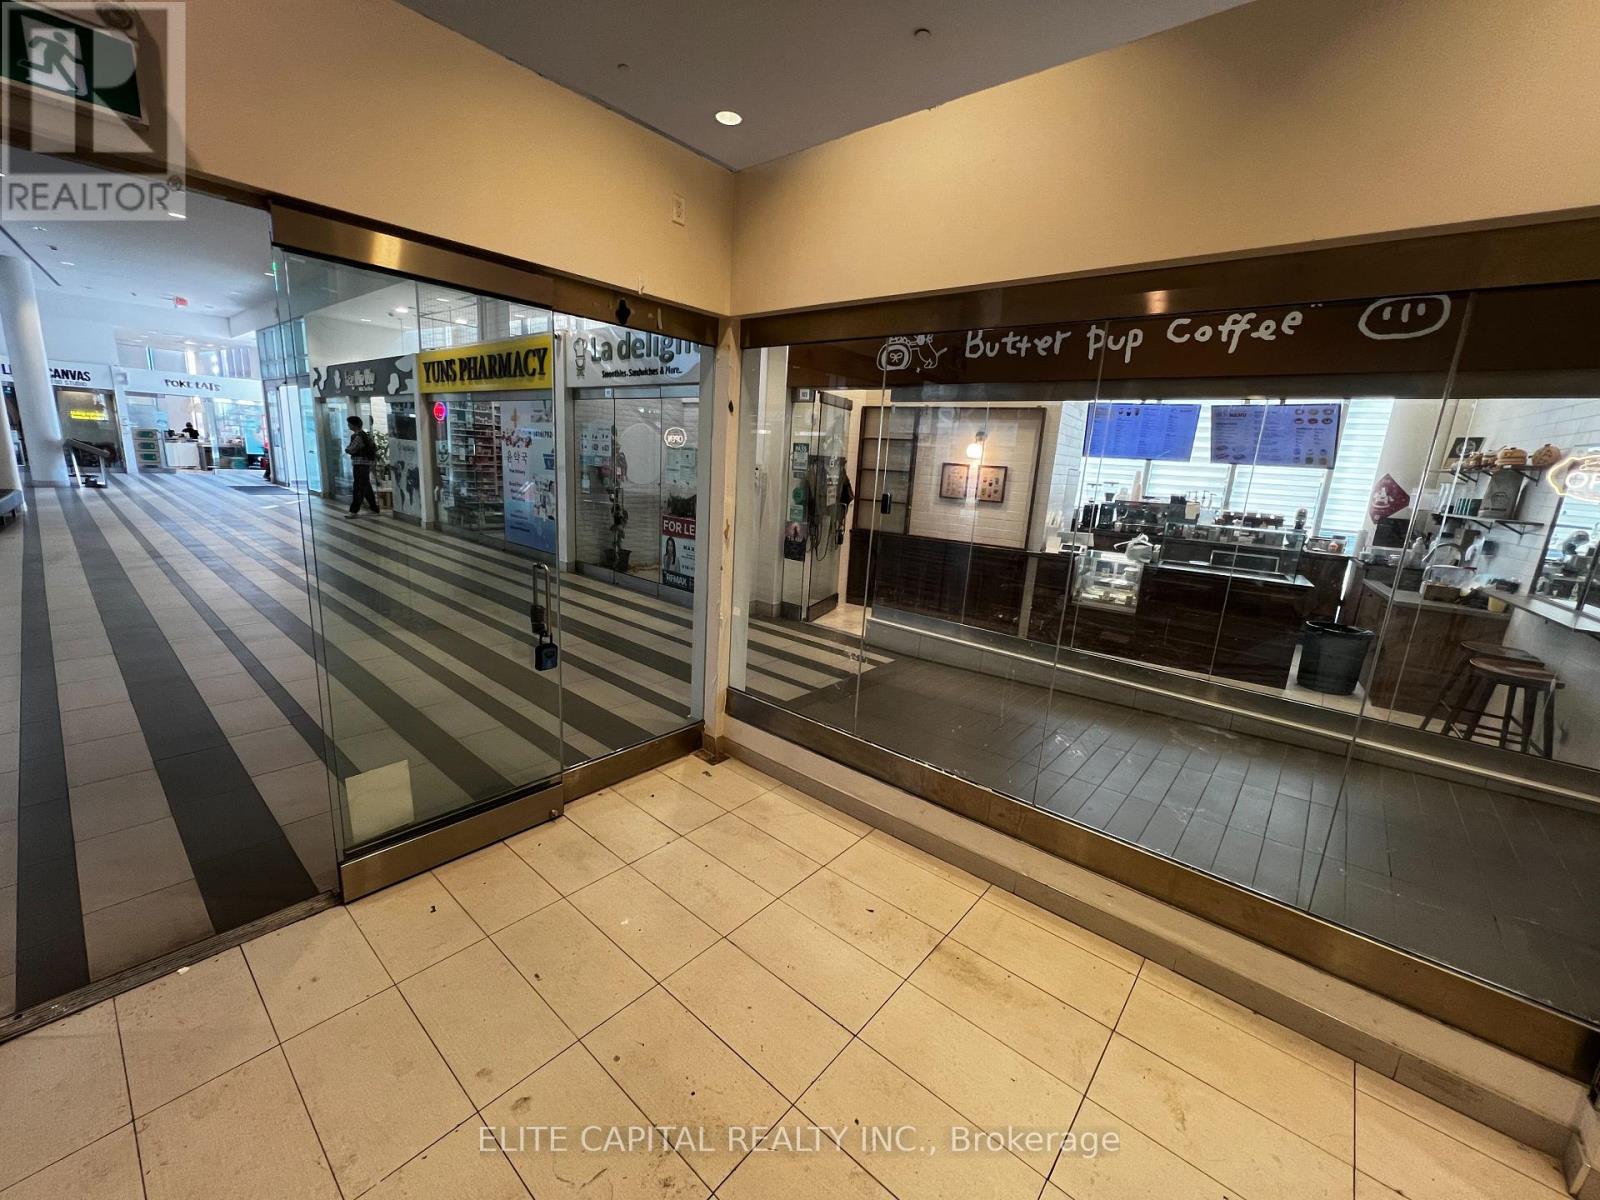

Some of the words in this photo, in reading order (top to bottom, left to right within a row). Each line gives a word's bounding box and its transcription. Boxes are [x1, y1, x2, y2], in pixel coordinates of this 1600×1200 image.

[591, 336, 613, 362] La
[965, 329, 1072, 359] Butter
[1166, 310, 1303, 354] Coffee
[458, 347, 549, 381] PHARMACY
[663, 519, 682, 534] FOR
